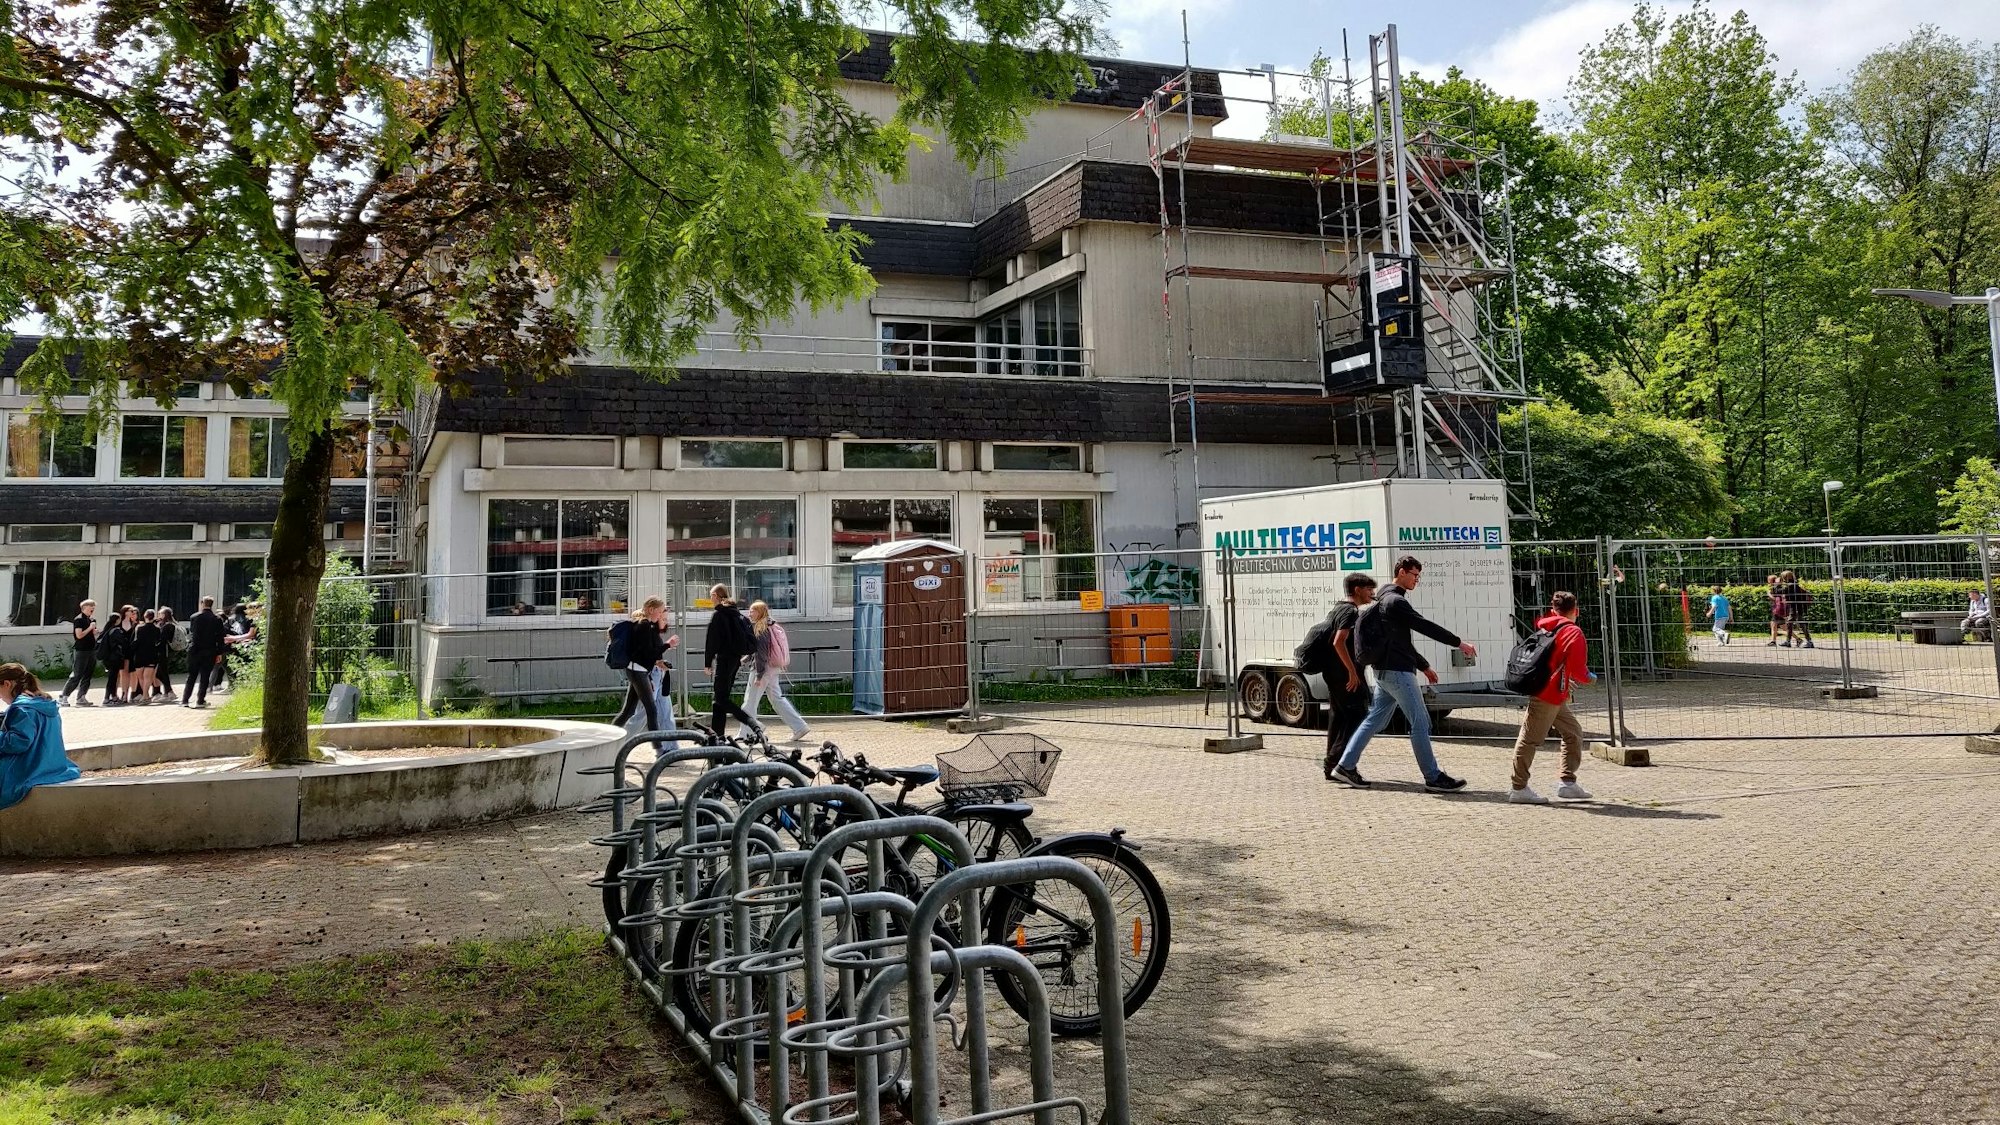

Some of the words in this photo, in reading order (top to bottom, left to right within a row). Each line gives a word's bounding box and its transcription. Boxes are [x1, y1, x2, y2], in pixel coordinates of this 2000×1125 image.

[1216, 523, 1336, 557] MULTITECH
[1399, 526, 1480, 541] MULTITECH
[1302, 556, 1335, 570] GMBH
